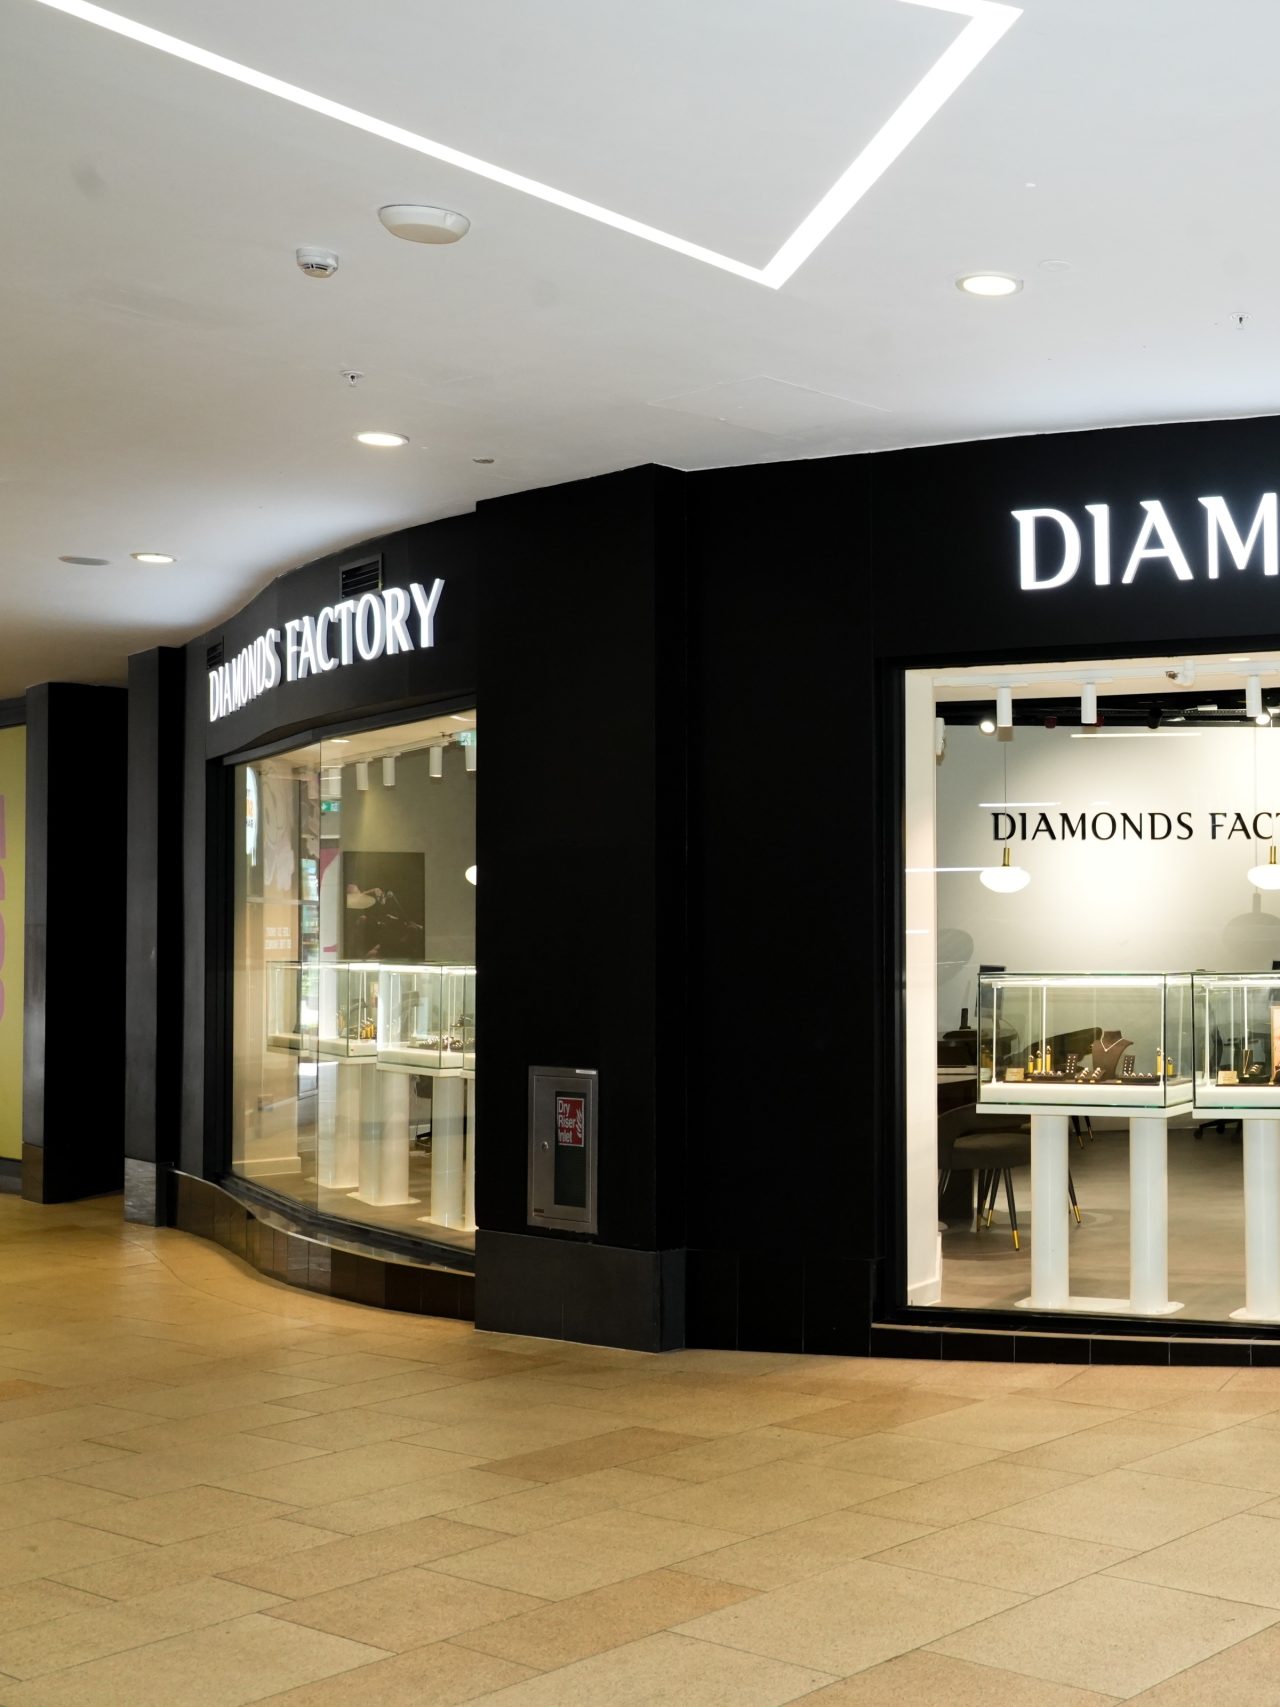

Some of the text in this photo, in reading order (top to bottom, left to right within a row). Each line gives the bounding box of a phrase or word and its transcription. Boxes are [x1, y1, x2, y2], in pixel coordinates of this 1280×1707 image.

[208, 578, 446, 723] DIAMONDS FACTORY
[991, 812, 1194, 841] DIAMONDS
[558, 1100, 570, 1117] Dry
[558, 1115, 576, 1128] Riser
[558, 1128, 572, 1143] Inlet
